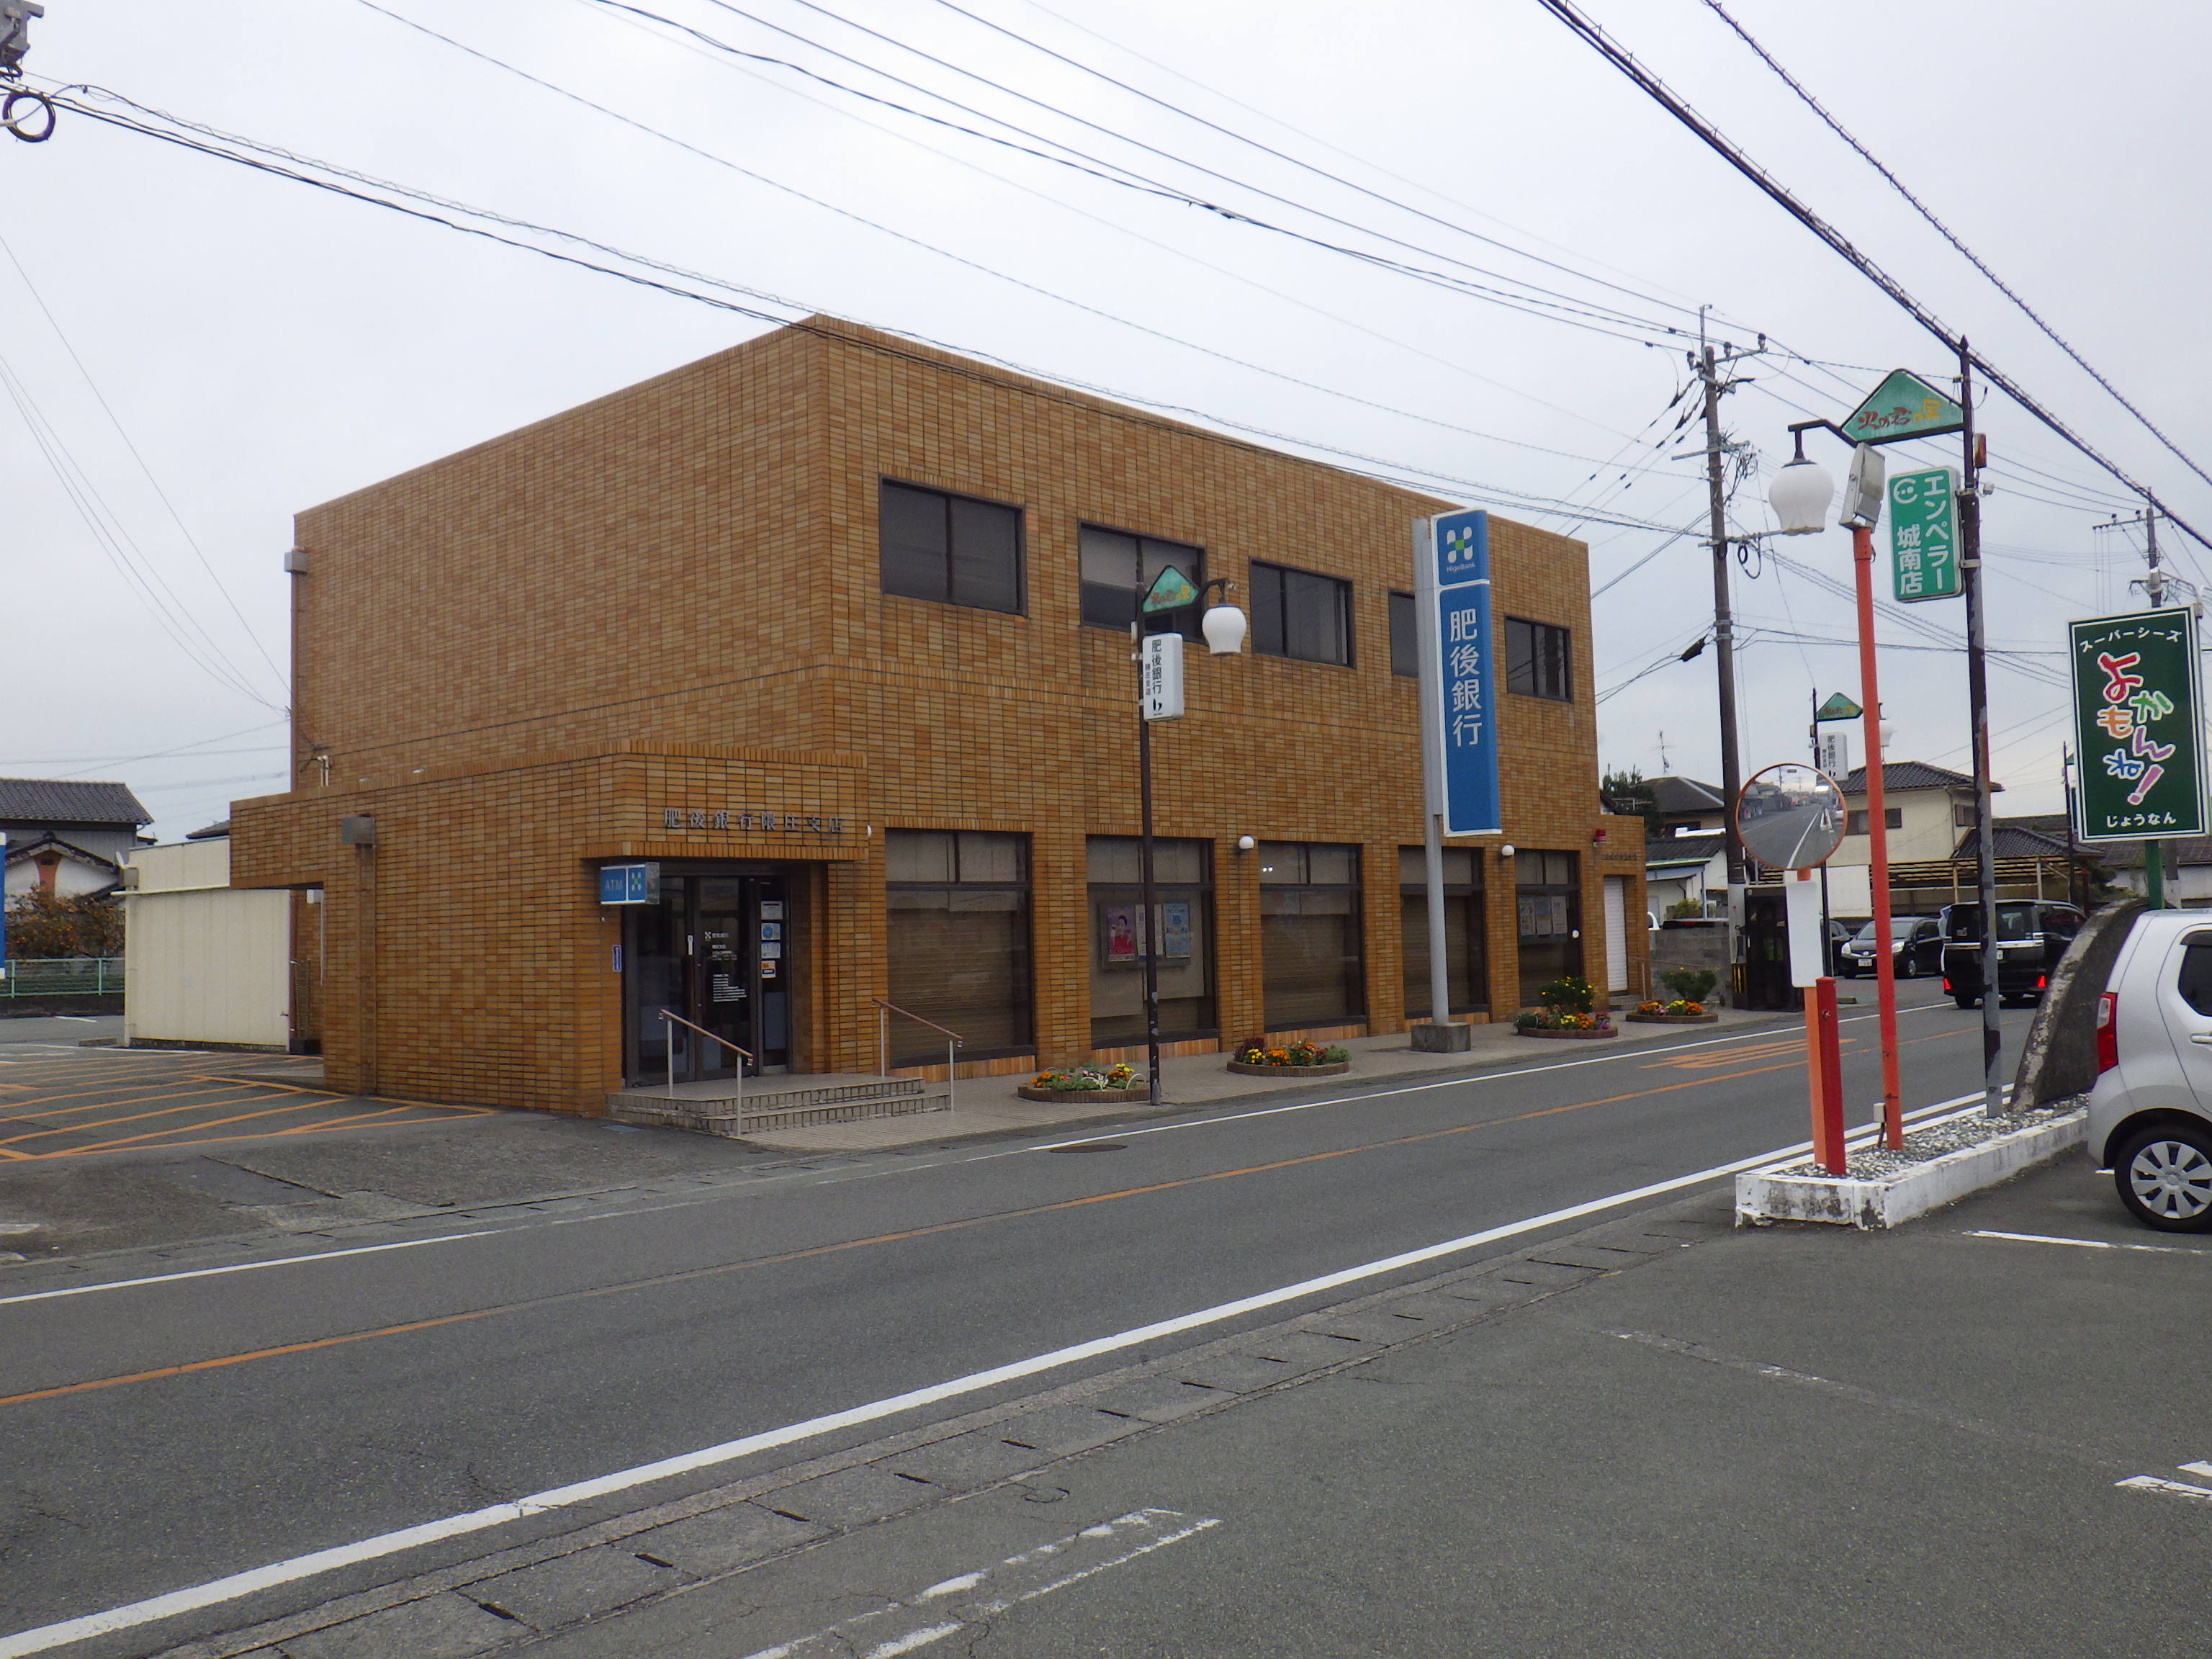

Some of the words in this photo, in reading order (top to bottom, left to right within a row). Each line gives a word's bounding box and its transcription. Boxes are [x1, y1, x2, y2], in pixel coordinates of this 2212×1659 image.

[1897, 523, 1923, 595] 城南店
[1923, 475, 1949, 590] エンペラー
[1151, 639, 1162, 695] 肥後銀行
[1449, 608, 1483, 747] 肥後銀行
[664, 806, 843, 835] 肥後銀行隈庄支店
[2106, 811, 2177, 828] じょうなん
[605, 879, 623, 891] ATM
